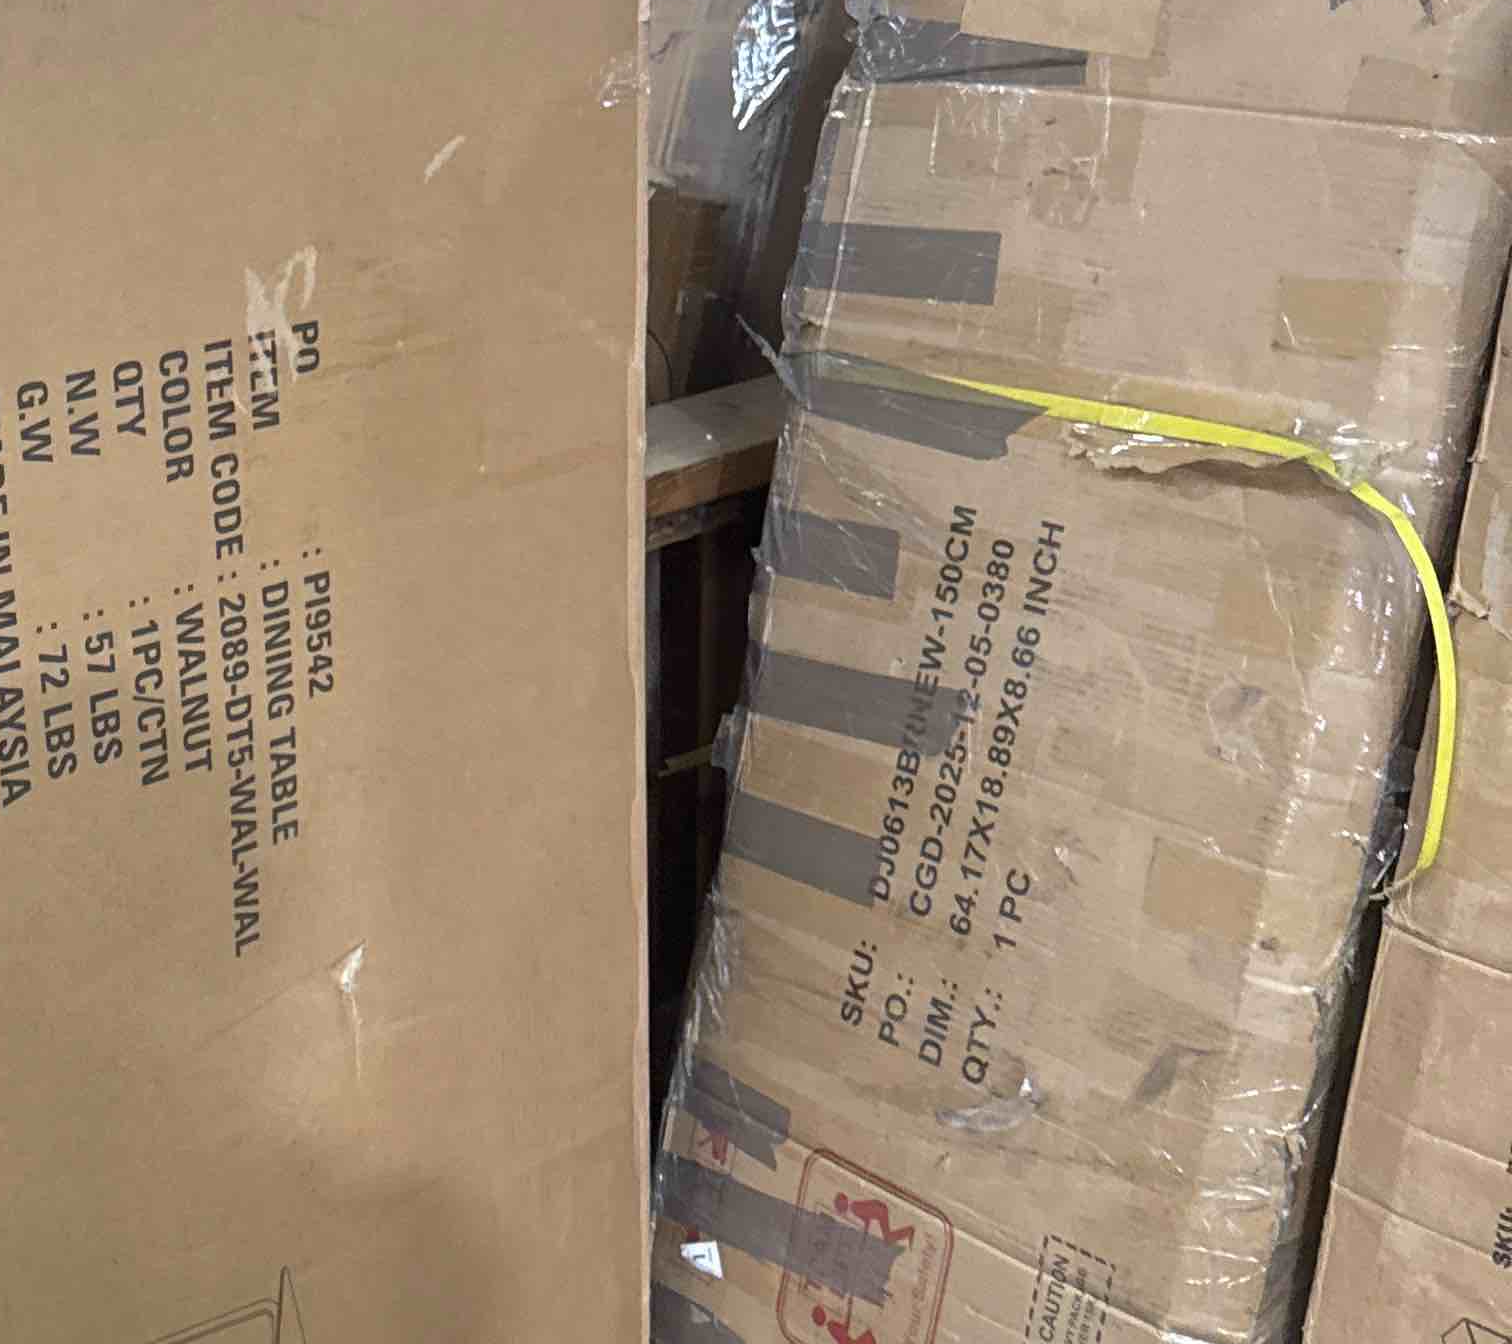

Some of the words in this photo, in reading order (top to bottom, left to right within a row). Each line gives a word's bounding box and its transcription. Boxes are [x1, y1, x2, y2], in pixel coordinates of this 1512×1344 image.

[203, 339, 237, 441] ITEM
[247, 331, 280, 433] ITEM
[291, 320, 320, 374] PO
[16, 381, 54, 464] G.W
[65, 369, 101, 458] N.W
[159, 350, 195, 483] COLOR
[209, 453, 244, 560] CODE
[112, 359, 147, 438] QTY
[131, 619, 170, 788] 1PC/CTN
[38, 644, 69, 694] 72
[84, 631, 116, 675] 57
[175, 601, 213, 774] WALNUT
[261, 579, 294, 723] DINING
[43, 702, 78, 780] LBS
[90, 688, 123, 766] LBS
[218, 592, 261, 957] 2089-DT5-WAL-WAL
[269, 733, 299, 846] TABLE
[918, 978, 959, 1068] DIM.:
[949, 624, 1042, 937] 64.17X18.89X8.66
[1023, 520, 1066, 617] INCH
[1000, 867, 1032, 926] PC
[839, 938, 879, 1027] SKU:
[993, 932, 1017, 952] 1
[878, 973, 916, 1047] PO.:
[961, 989, 1004, 1086] QTY.:
[1038, 1253, 1071, 1341] CAUTION
